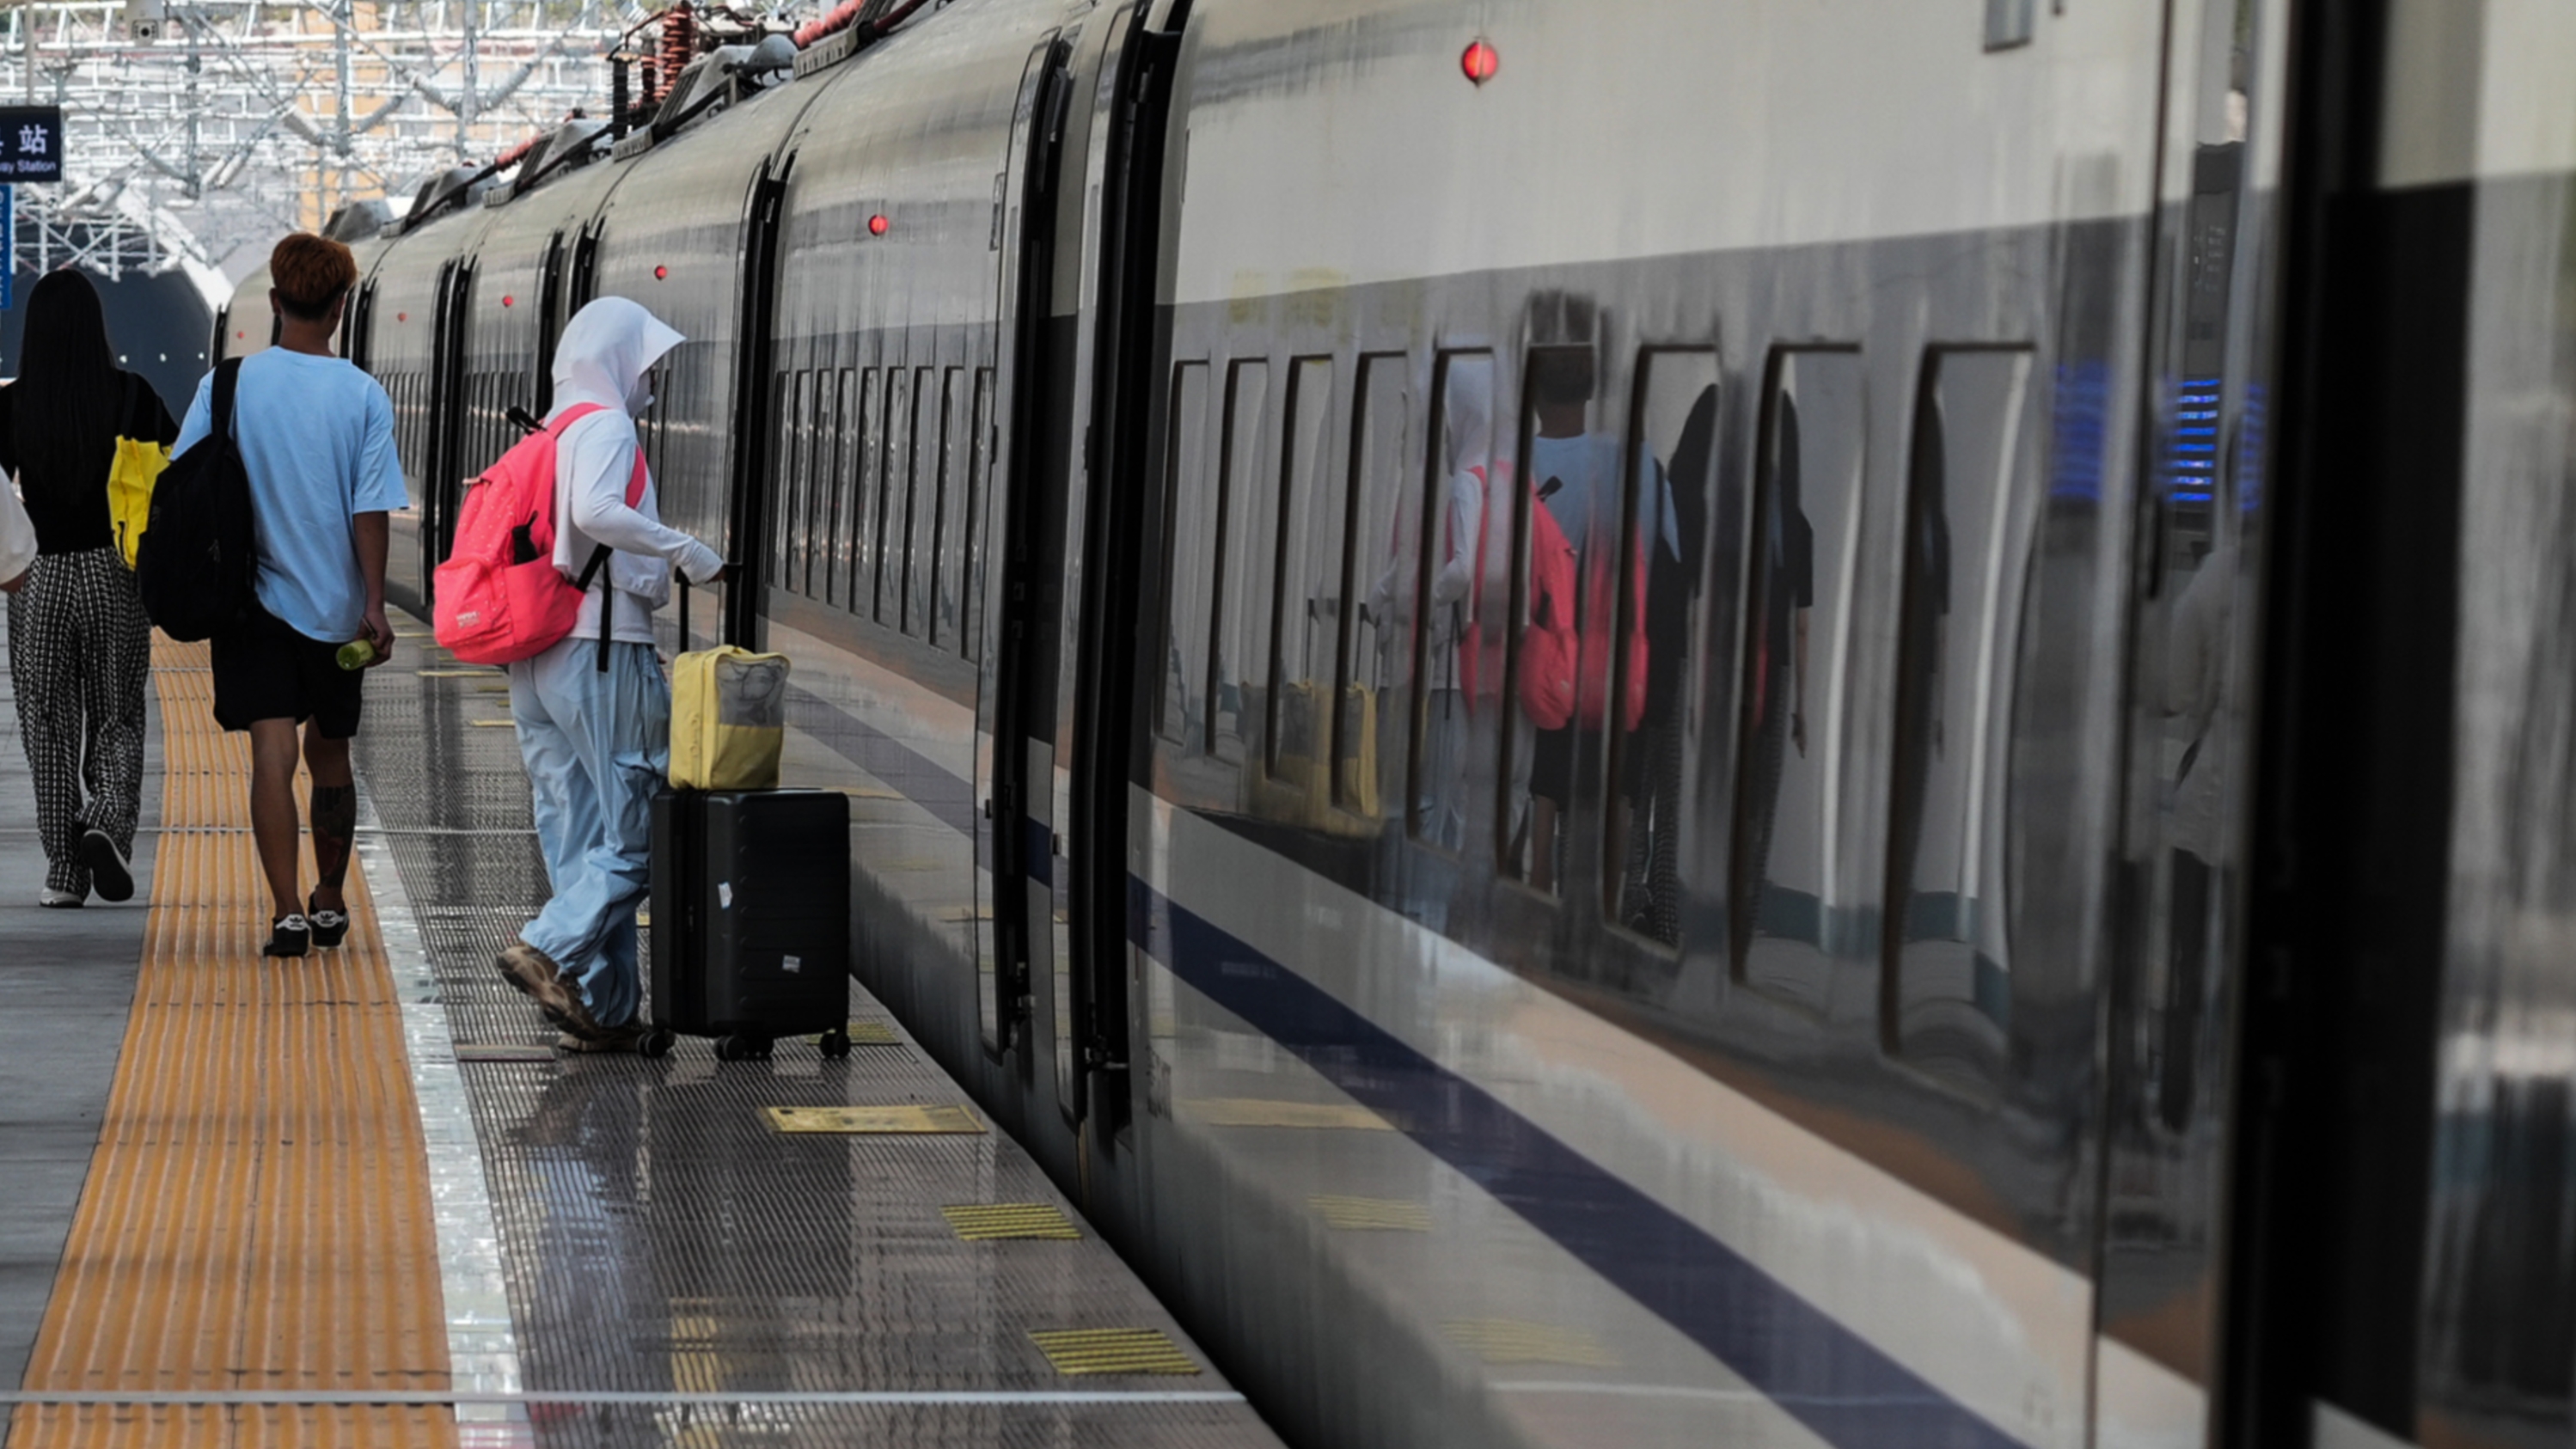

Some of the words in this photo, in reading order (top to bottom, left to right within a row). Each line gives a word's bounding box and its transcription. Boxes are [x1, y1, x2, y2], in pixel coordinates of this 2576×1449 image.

[0, 125, 48, 155] 站
[0, 162, 15, 174] ay
[17, 159, 56, 173] Station
